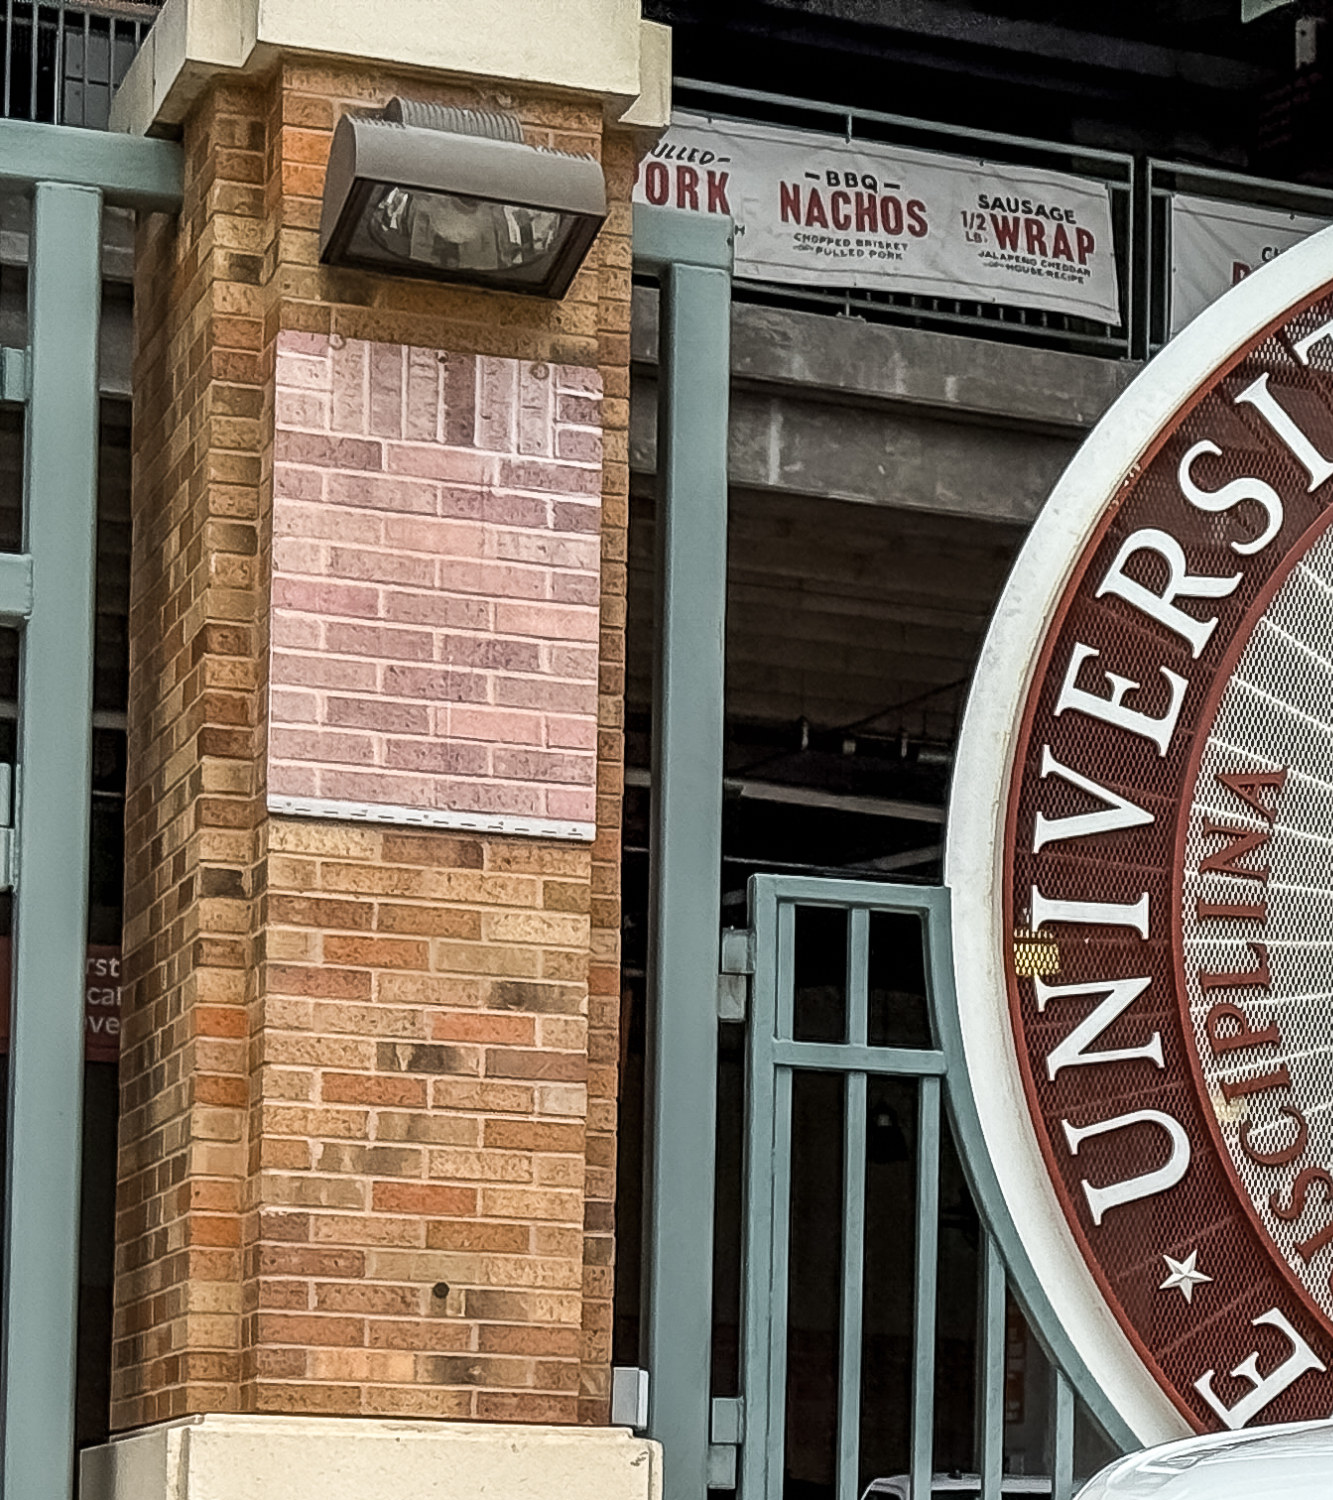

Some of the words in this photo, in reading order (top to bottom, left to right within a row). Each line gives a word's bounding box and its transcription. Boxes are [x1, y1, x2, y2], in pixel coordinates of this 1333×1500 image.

[651, 143, 715, 166] ULLED
[637, 161, 731, 215] ORK
[826, 170, 879, 193] BBQ
[780, 181, 929, 238] NACHOS
[978, 194, 1077, 225] SAUSAGE
[793, 232, 851, 247] CHOPPED
[855, 239, 908, 251] BRISKET
[960, 210, 987, 231] 1/2
[989, 212, 1095, 266] WRAP
[815, 246, 865, 258] PULLED
[868, 249, 903, 260] PORK
[1040, 259, 1091, 277] CHEDDAR
[86, 958, 120, 978] rst
